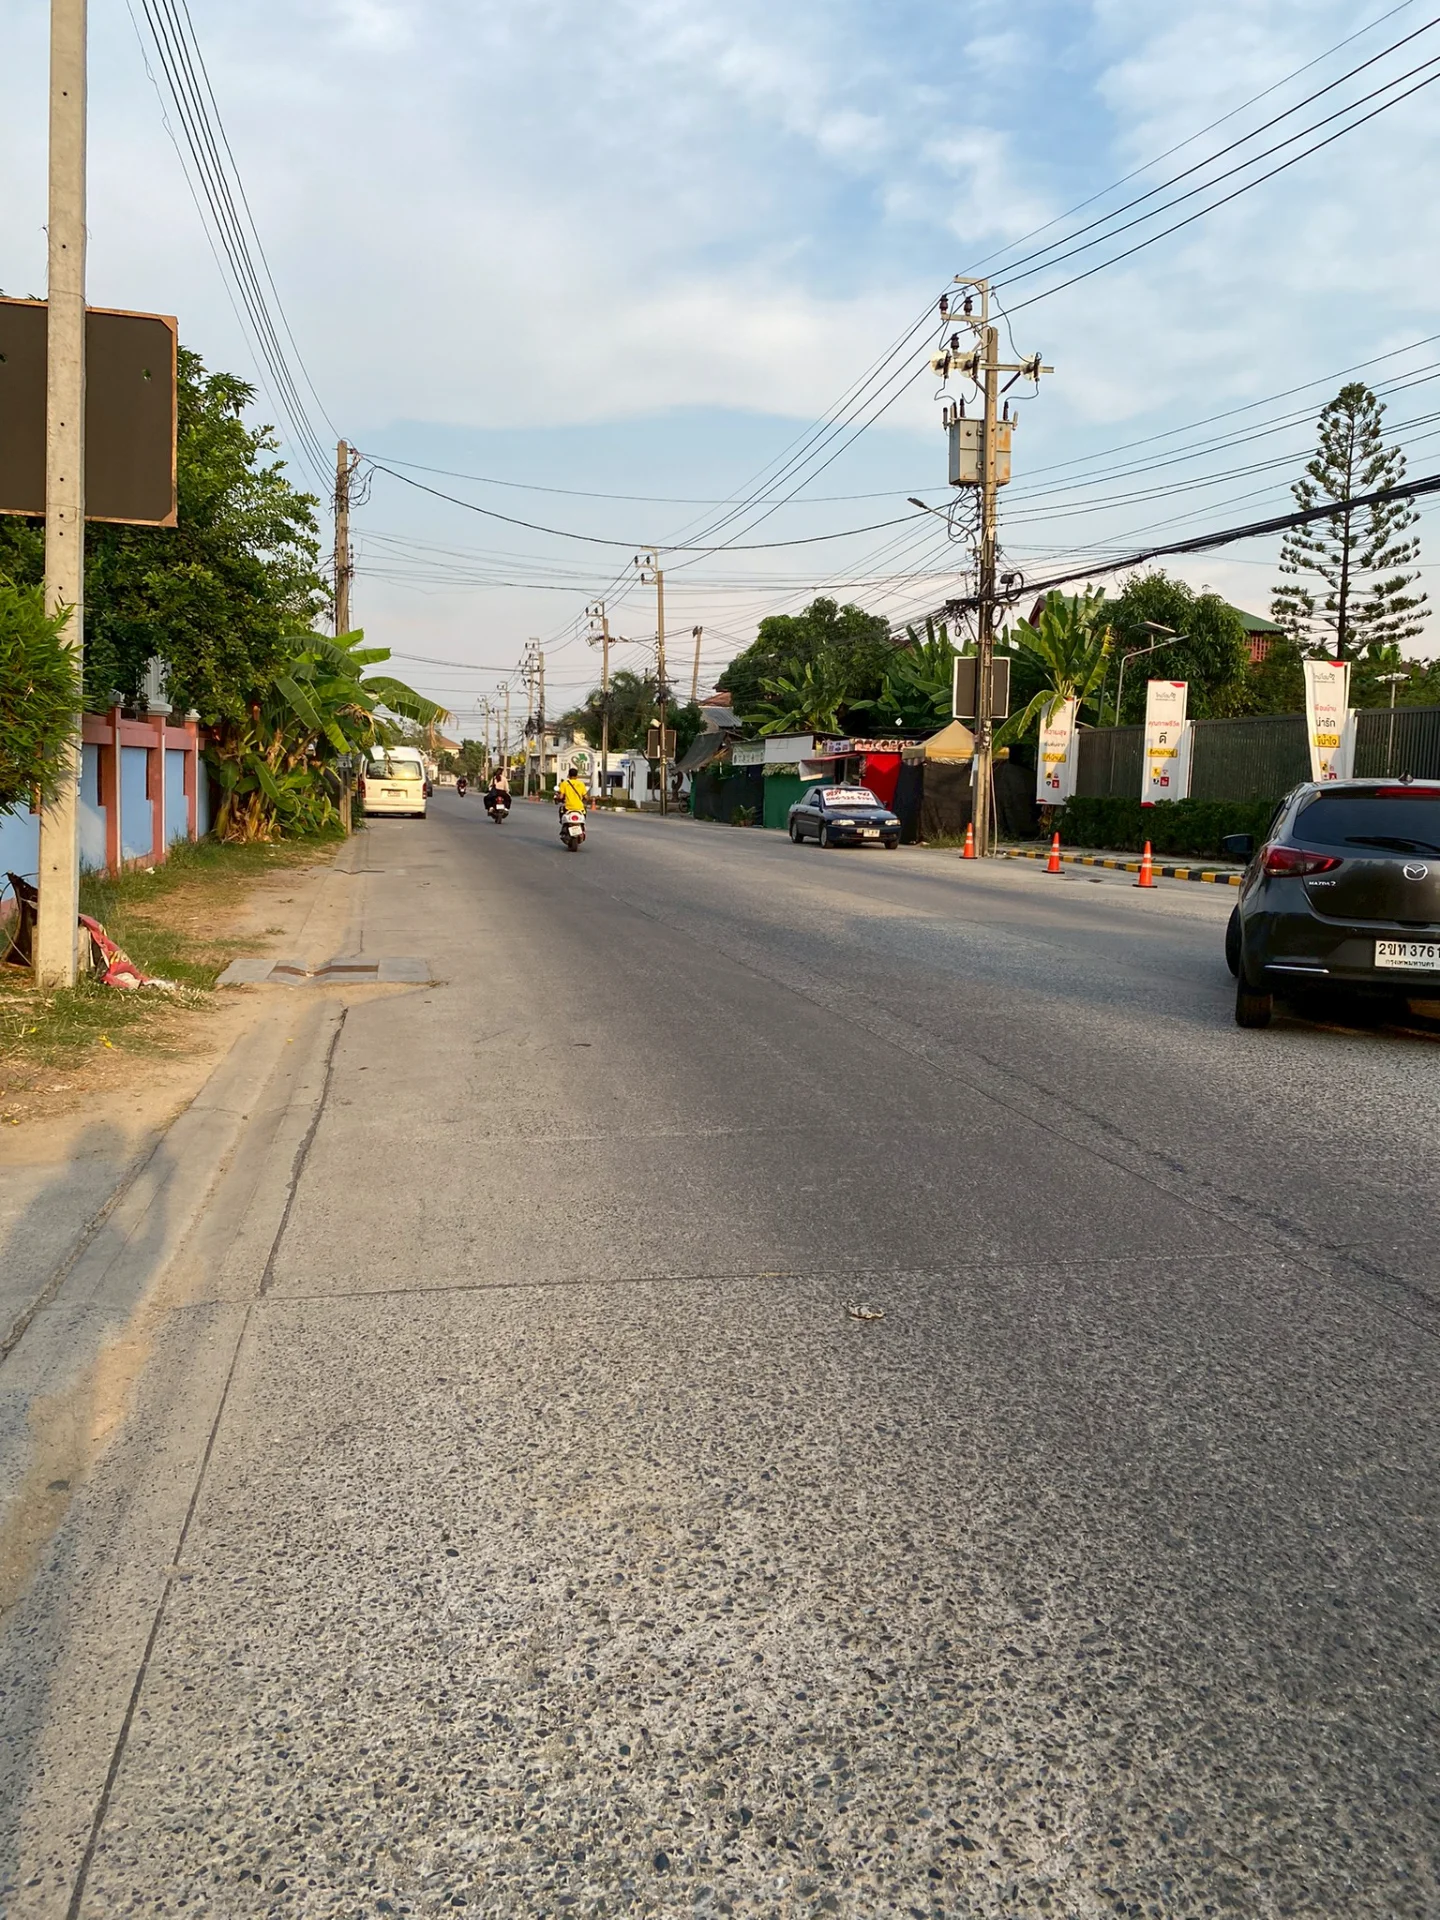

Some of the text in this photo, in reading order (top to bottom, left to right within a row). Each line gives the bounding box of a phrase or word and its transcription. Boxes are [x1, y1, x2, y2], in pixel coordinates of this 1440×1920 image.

[1316, 717, 1336, 728] น่ารัก
[1159, 731, 1168, 744] ดี
[1378, 943, 1407, 957] 2ขท
[1385, 958, 1435, 968] กรุงเทพมหานคร
